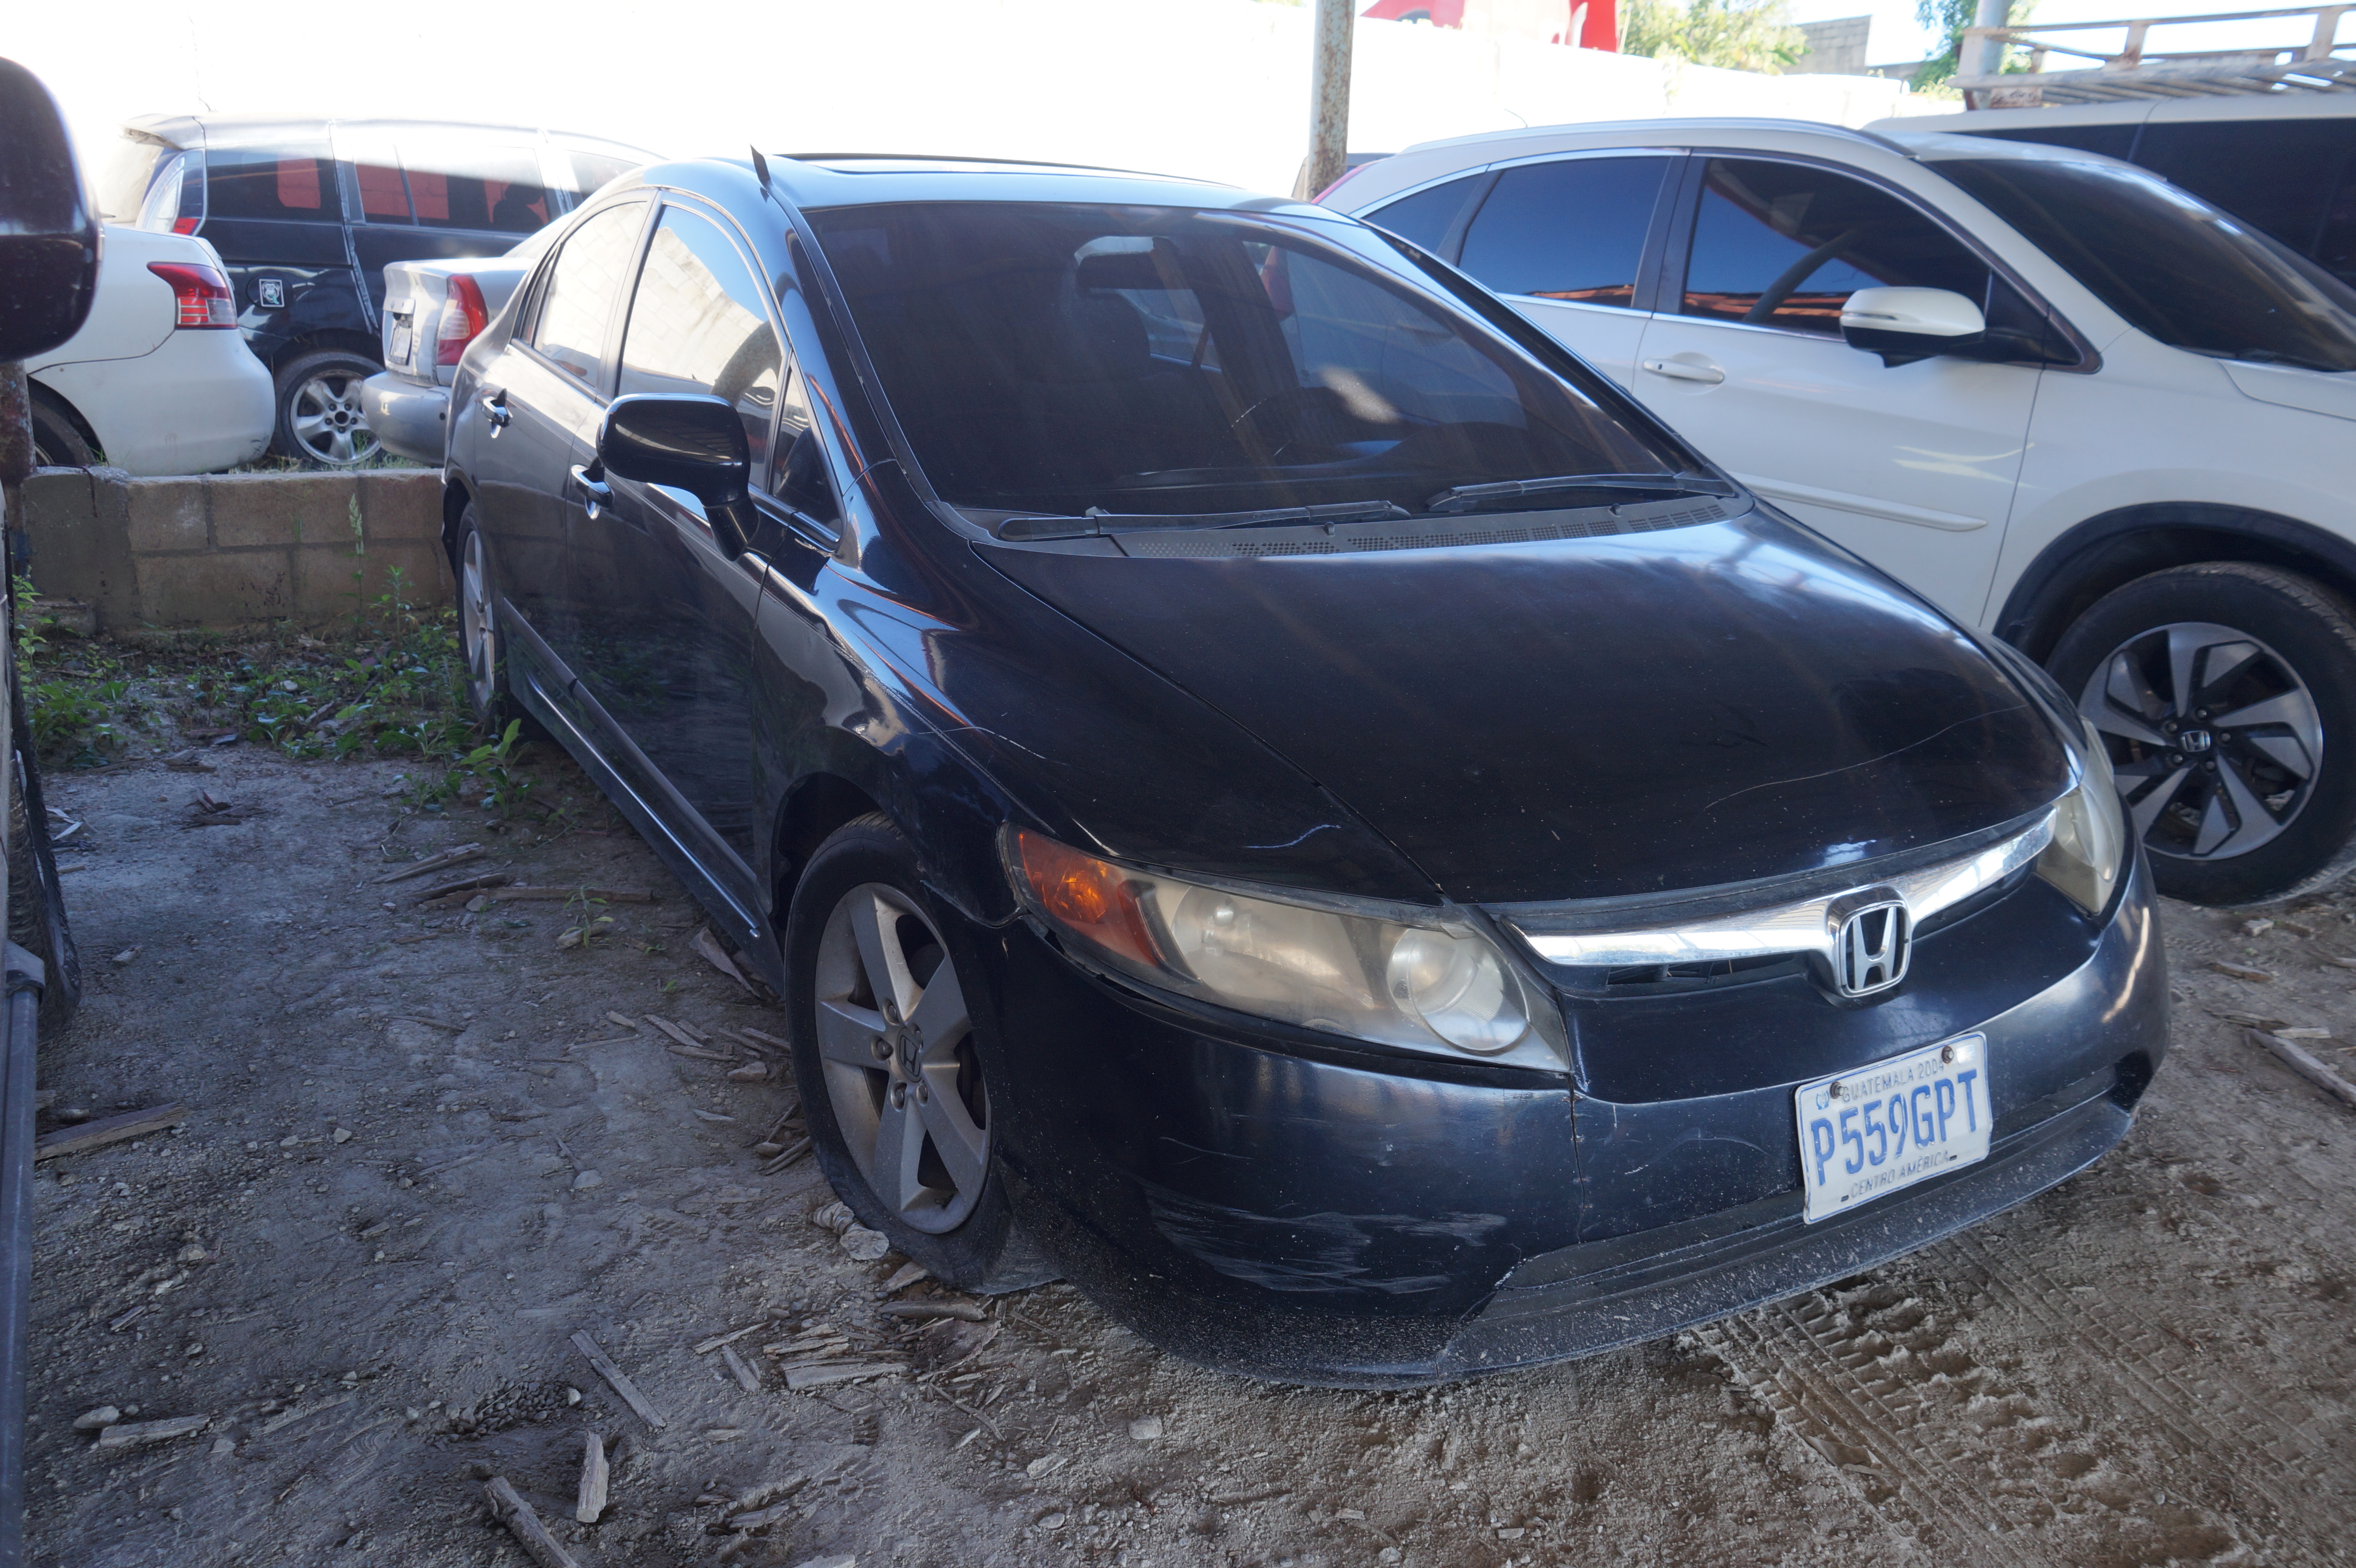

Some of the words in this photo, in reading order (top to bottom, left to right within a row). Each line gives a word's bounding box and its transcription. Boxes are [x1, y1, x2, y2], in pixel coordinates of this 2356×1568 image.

[1843, 1066, 1915, 1102] GUATEMALA
[1810, 1068, 1978, 1187] P559GPT
[1850, 1172, 1895, 1199] CENTRO
